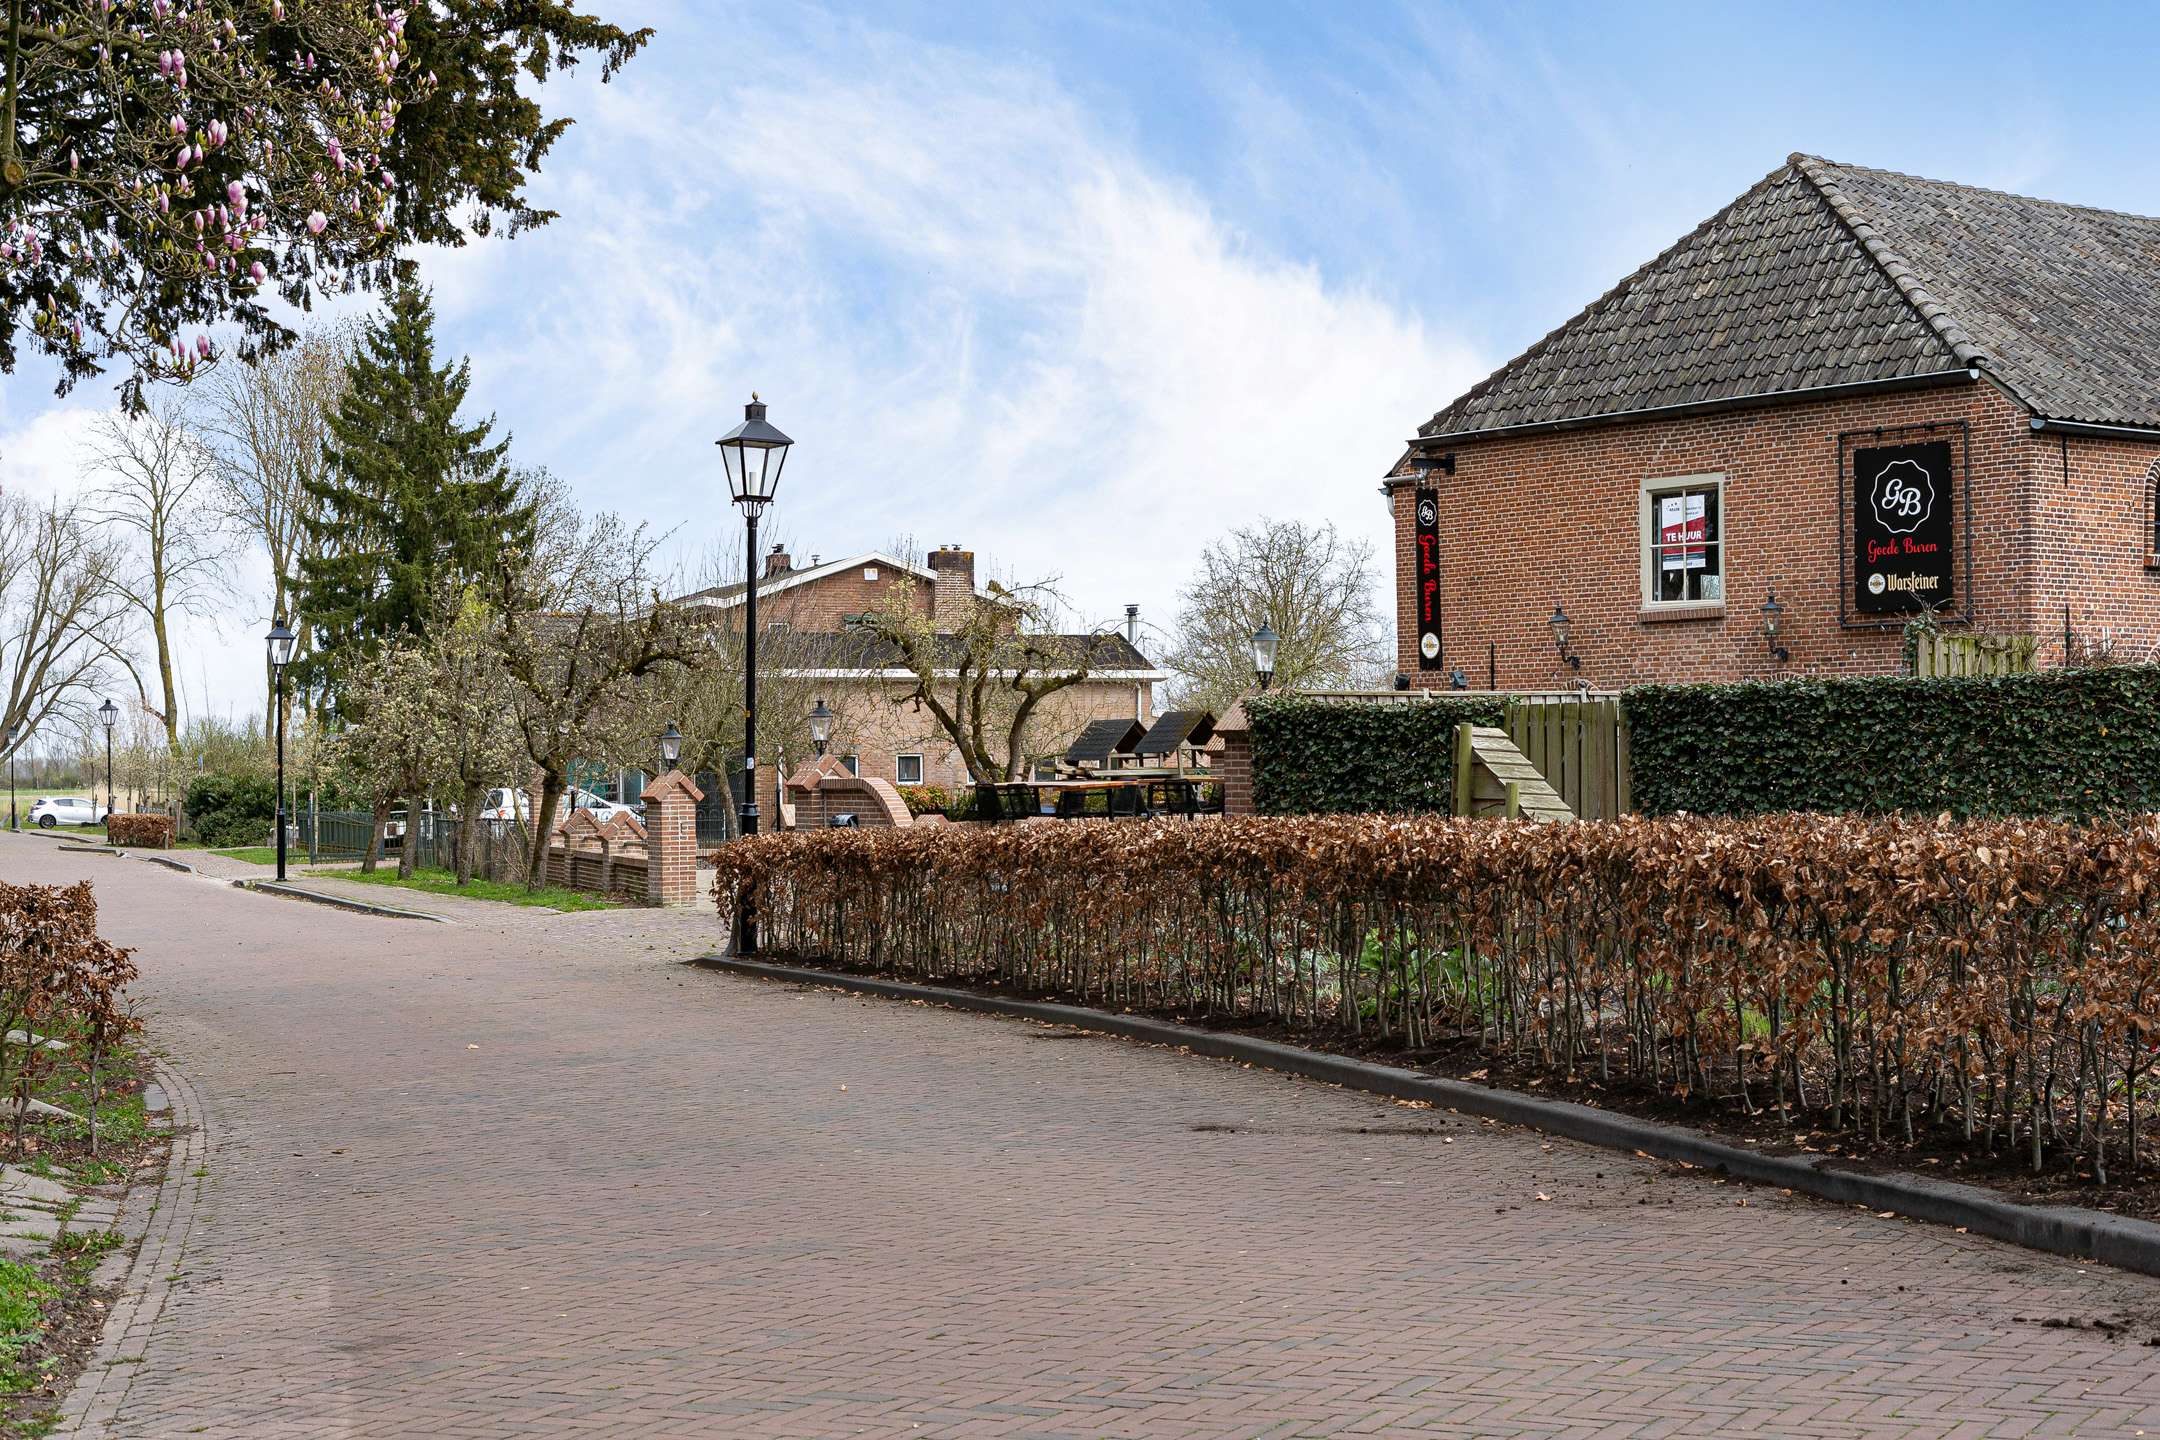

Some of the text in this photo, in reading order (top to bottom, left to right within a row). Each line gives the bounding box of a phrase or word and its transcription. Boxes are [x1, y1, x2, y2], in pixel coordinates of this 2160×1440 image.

[1881, 478, 1922, 516] GB
[1666, 530, 1702, 542] TE HUUR
[1867, 537, 1939, 563] Goede Buren
[1418, 534, 1437, 623] Goede Buren
[1887, 571, 1939, 592] Warsteiner
